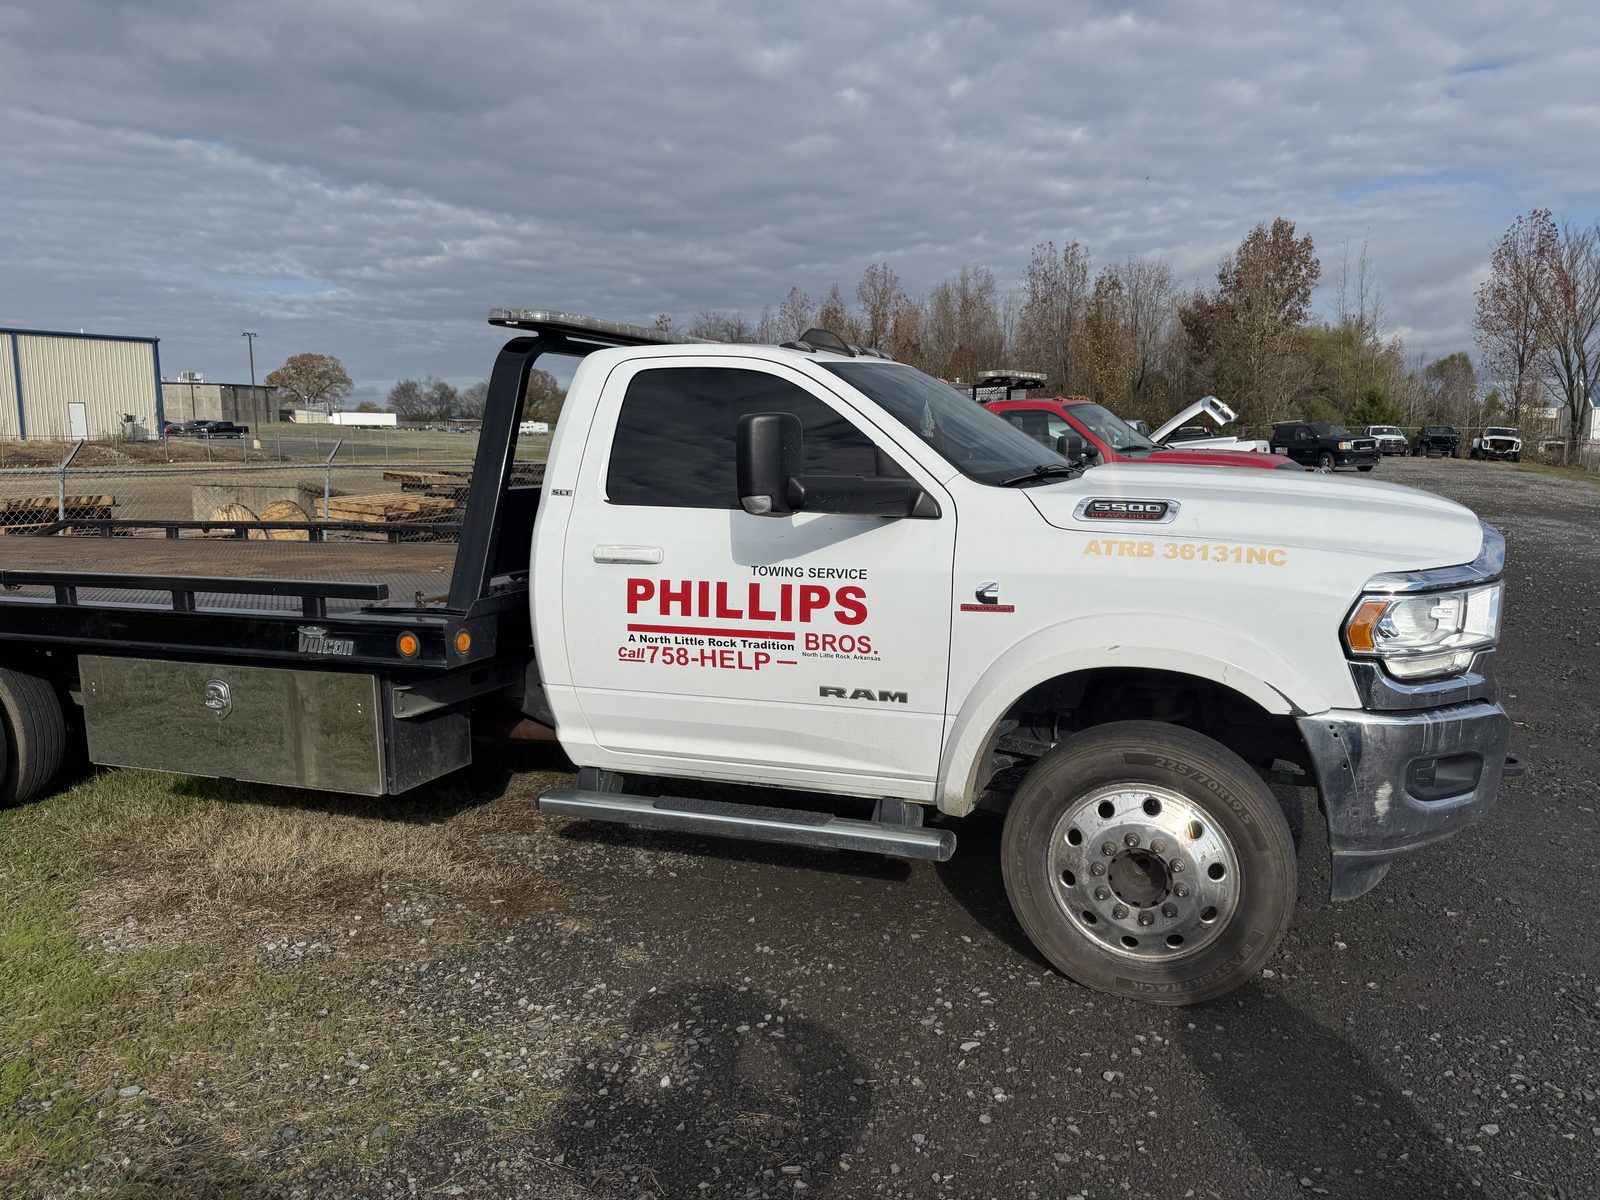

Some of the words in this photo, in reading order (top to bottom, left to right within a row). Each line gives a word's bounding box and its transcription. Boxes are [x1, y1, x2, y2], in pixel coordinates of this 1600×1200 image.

[1094, 503, 1161, 512] 5500
[1083, 539, 1155, 558] ATRB
[1163, 542, 1288, 567] 36131NC
[751, 565, 804, 578] TOWING
[808, 567, 867, 580] SERVICE
[627, 578, 868, 626] PHILLIPS
[628, 634, 636, 642] A
[639, 634, 671, 645] North
[674, 636, 705, 646] Little
[708, 638, 737, 648] Rock
[741, 639, 795, 651] Tradition
[805, 633, 878, 655] BROS.
[618, 646, 645, 659] Call
[646, 646, 771, 671] 758-HELP
[819, 685, 908, 703] RAM
[1154, 757, 1253, 825] 225/70R19.5
